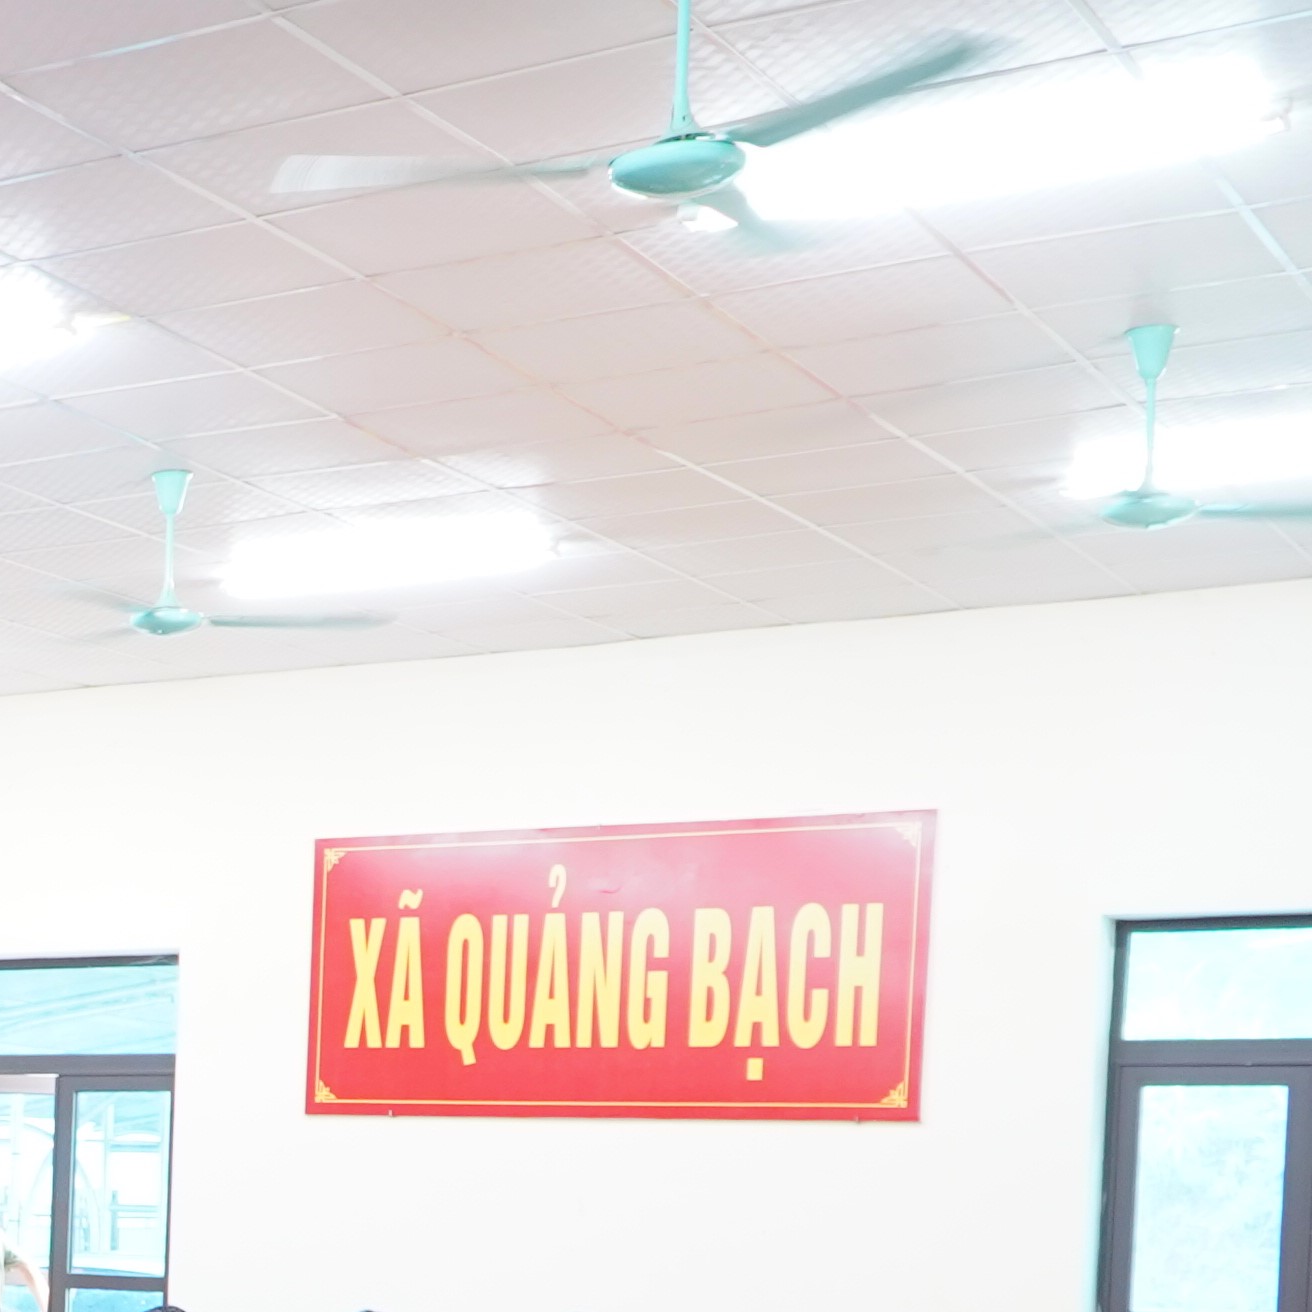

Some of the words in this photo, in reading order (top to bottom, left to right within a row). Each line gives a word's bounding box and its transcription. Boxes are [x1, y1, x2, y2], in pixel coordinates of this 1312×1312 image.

[343, 889, 425, 1049] XÃ
[444, 864, 670, 1066] QUẢNG
[688, 902, 884, 1081] BẠCH
